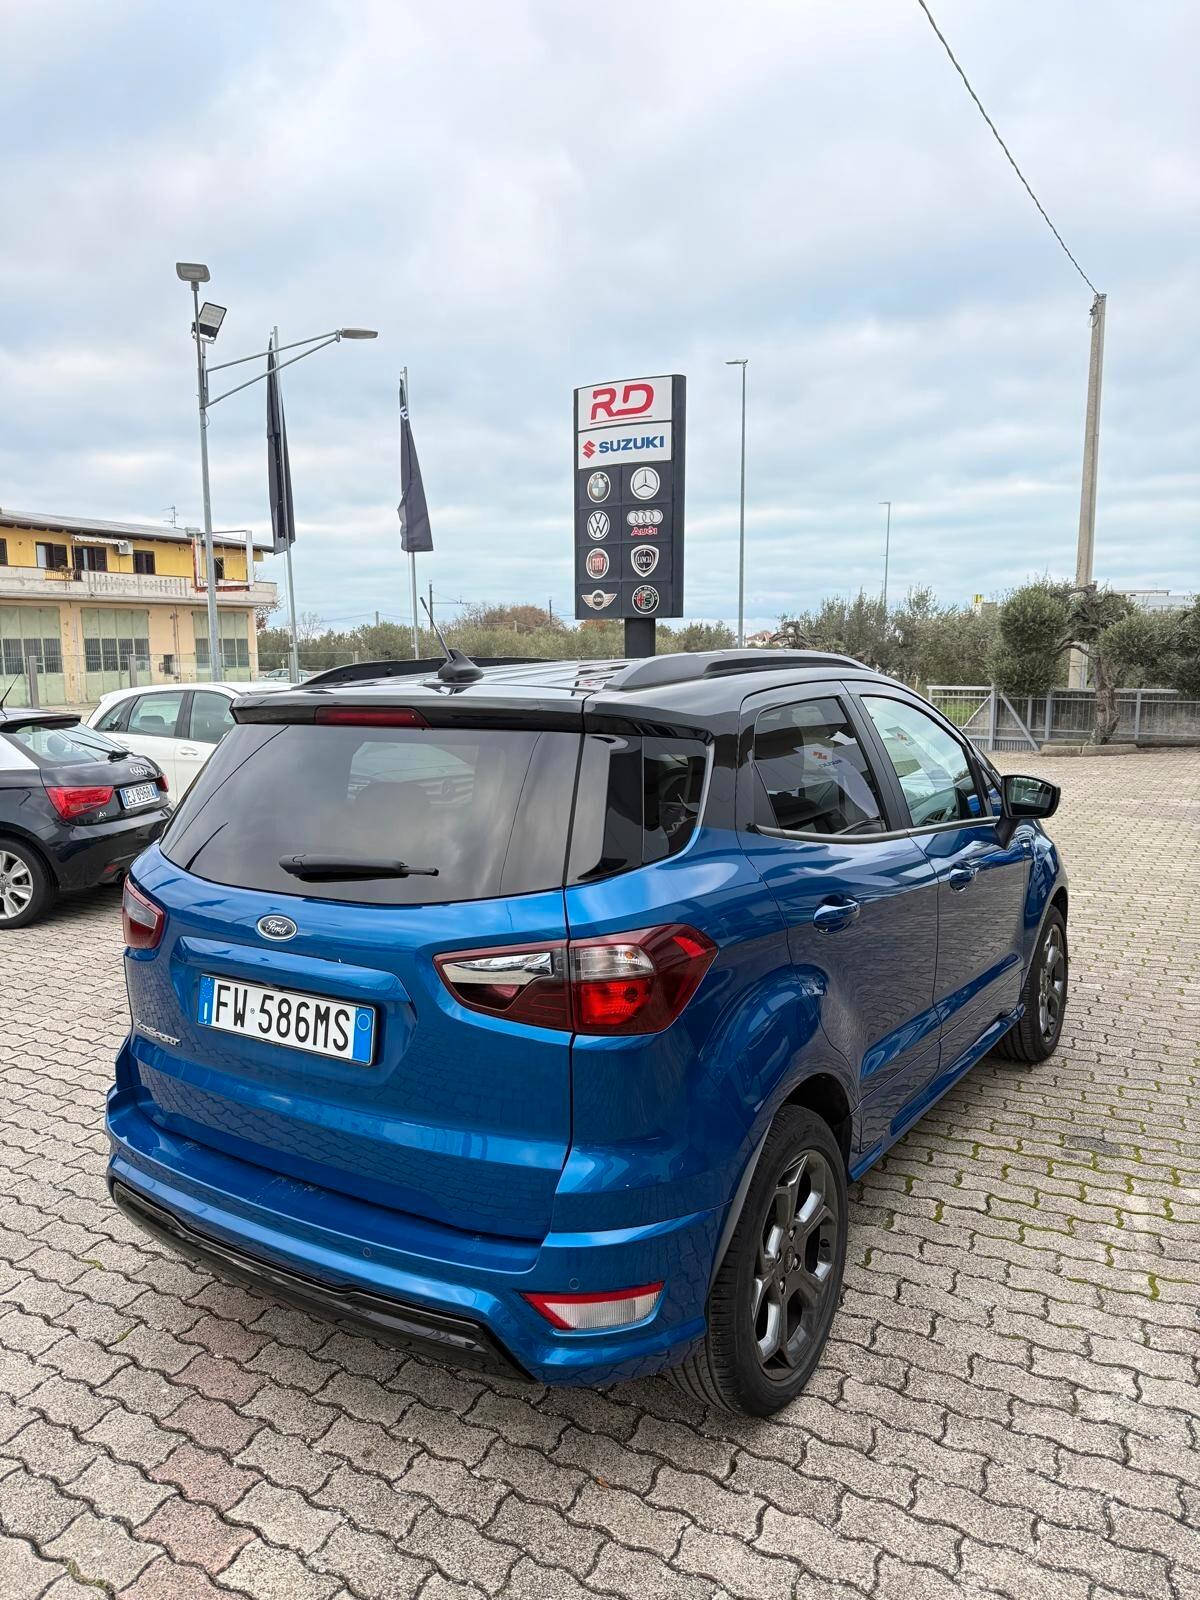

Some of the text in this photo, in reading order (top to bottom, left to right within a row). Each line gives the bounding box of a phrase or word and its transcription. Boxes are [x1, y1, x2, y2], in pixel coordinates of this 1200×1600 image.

[598, 435, 664, 454] SUZUKI
[631, 526, 658, 536] Audi
[126, 789, 136, 804] EJ
[266, 919, 288, 935] Ford
[216, 984, 351, 1052] FW 586MS
